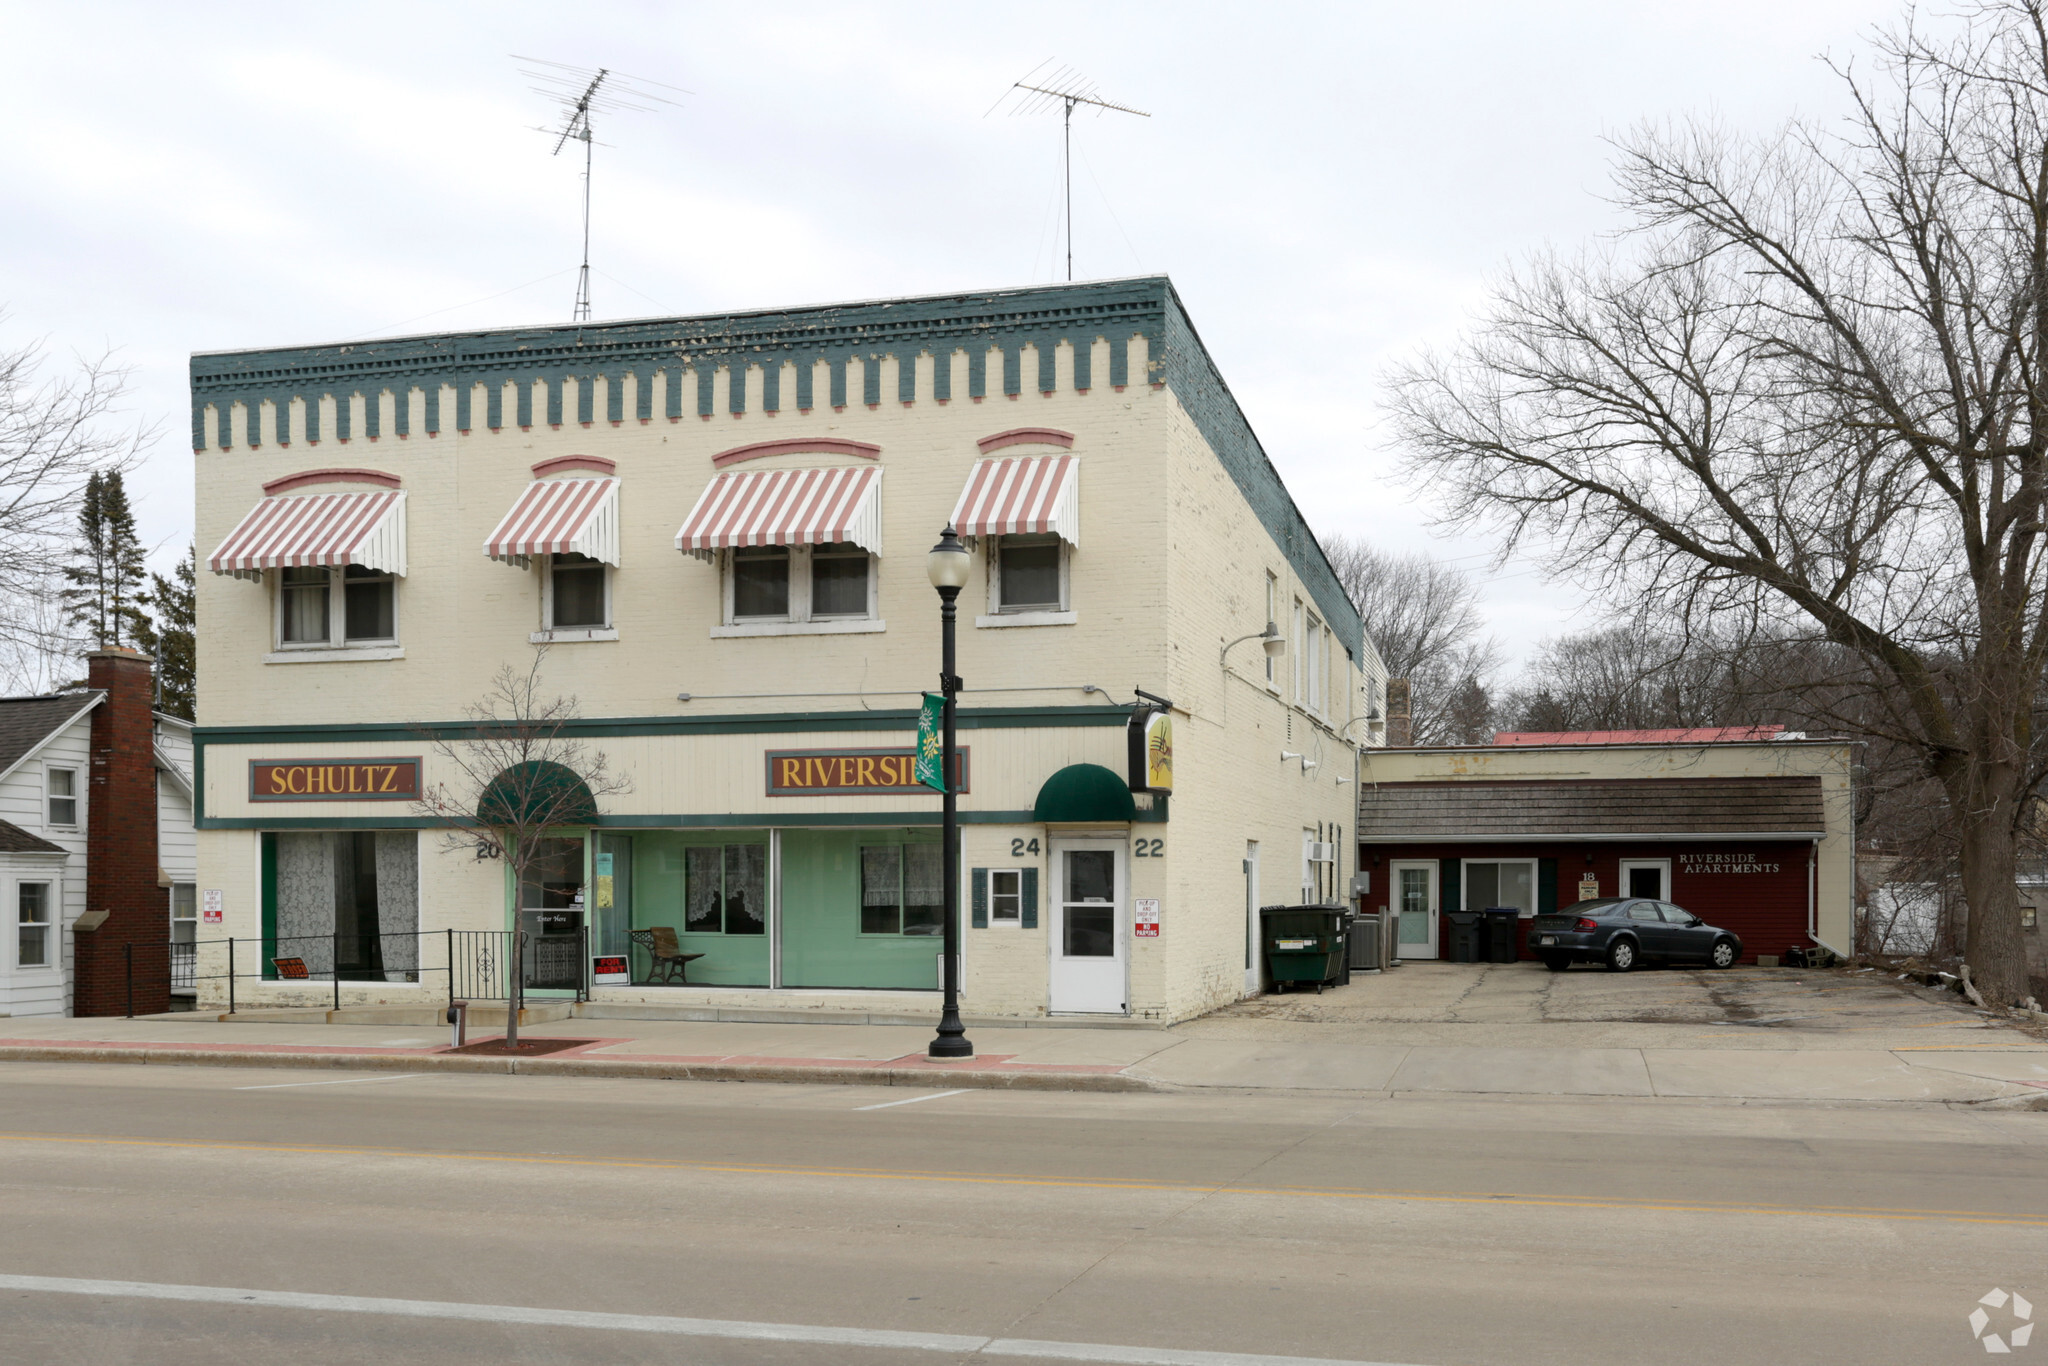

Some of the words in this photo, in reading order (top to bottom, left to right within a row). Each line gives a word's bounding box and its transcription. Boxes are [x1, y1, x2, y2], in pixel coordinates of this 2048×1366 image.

[782, 756, 943, 786] RIVERSI
[271, 765, 398, 794] SCHULTZ
[477, 841, 499, 859] 20
[1011, 838, 1040, 857] 24
[1135, 838, 1164, 857] 22
[1680, 853, 1756, 863] RIVERSIDE
[1684, 863, 1779, 873] APARTMENTS
[1583, 872, 1595, 881] 18
[553, 914, 567, 922] Here
[600, 958, 620, 966] FOR
[595, 965, 625, 974] RENT
